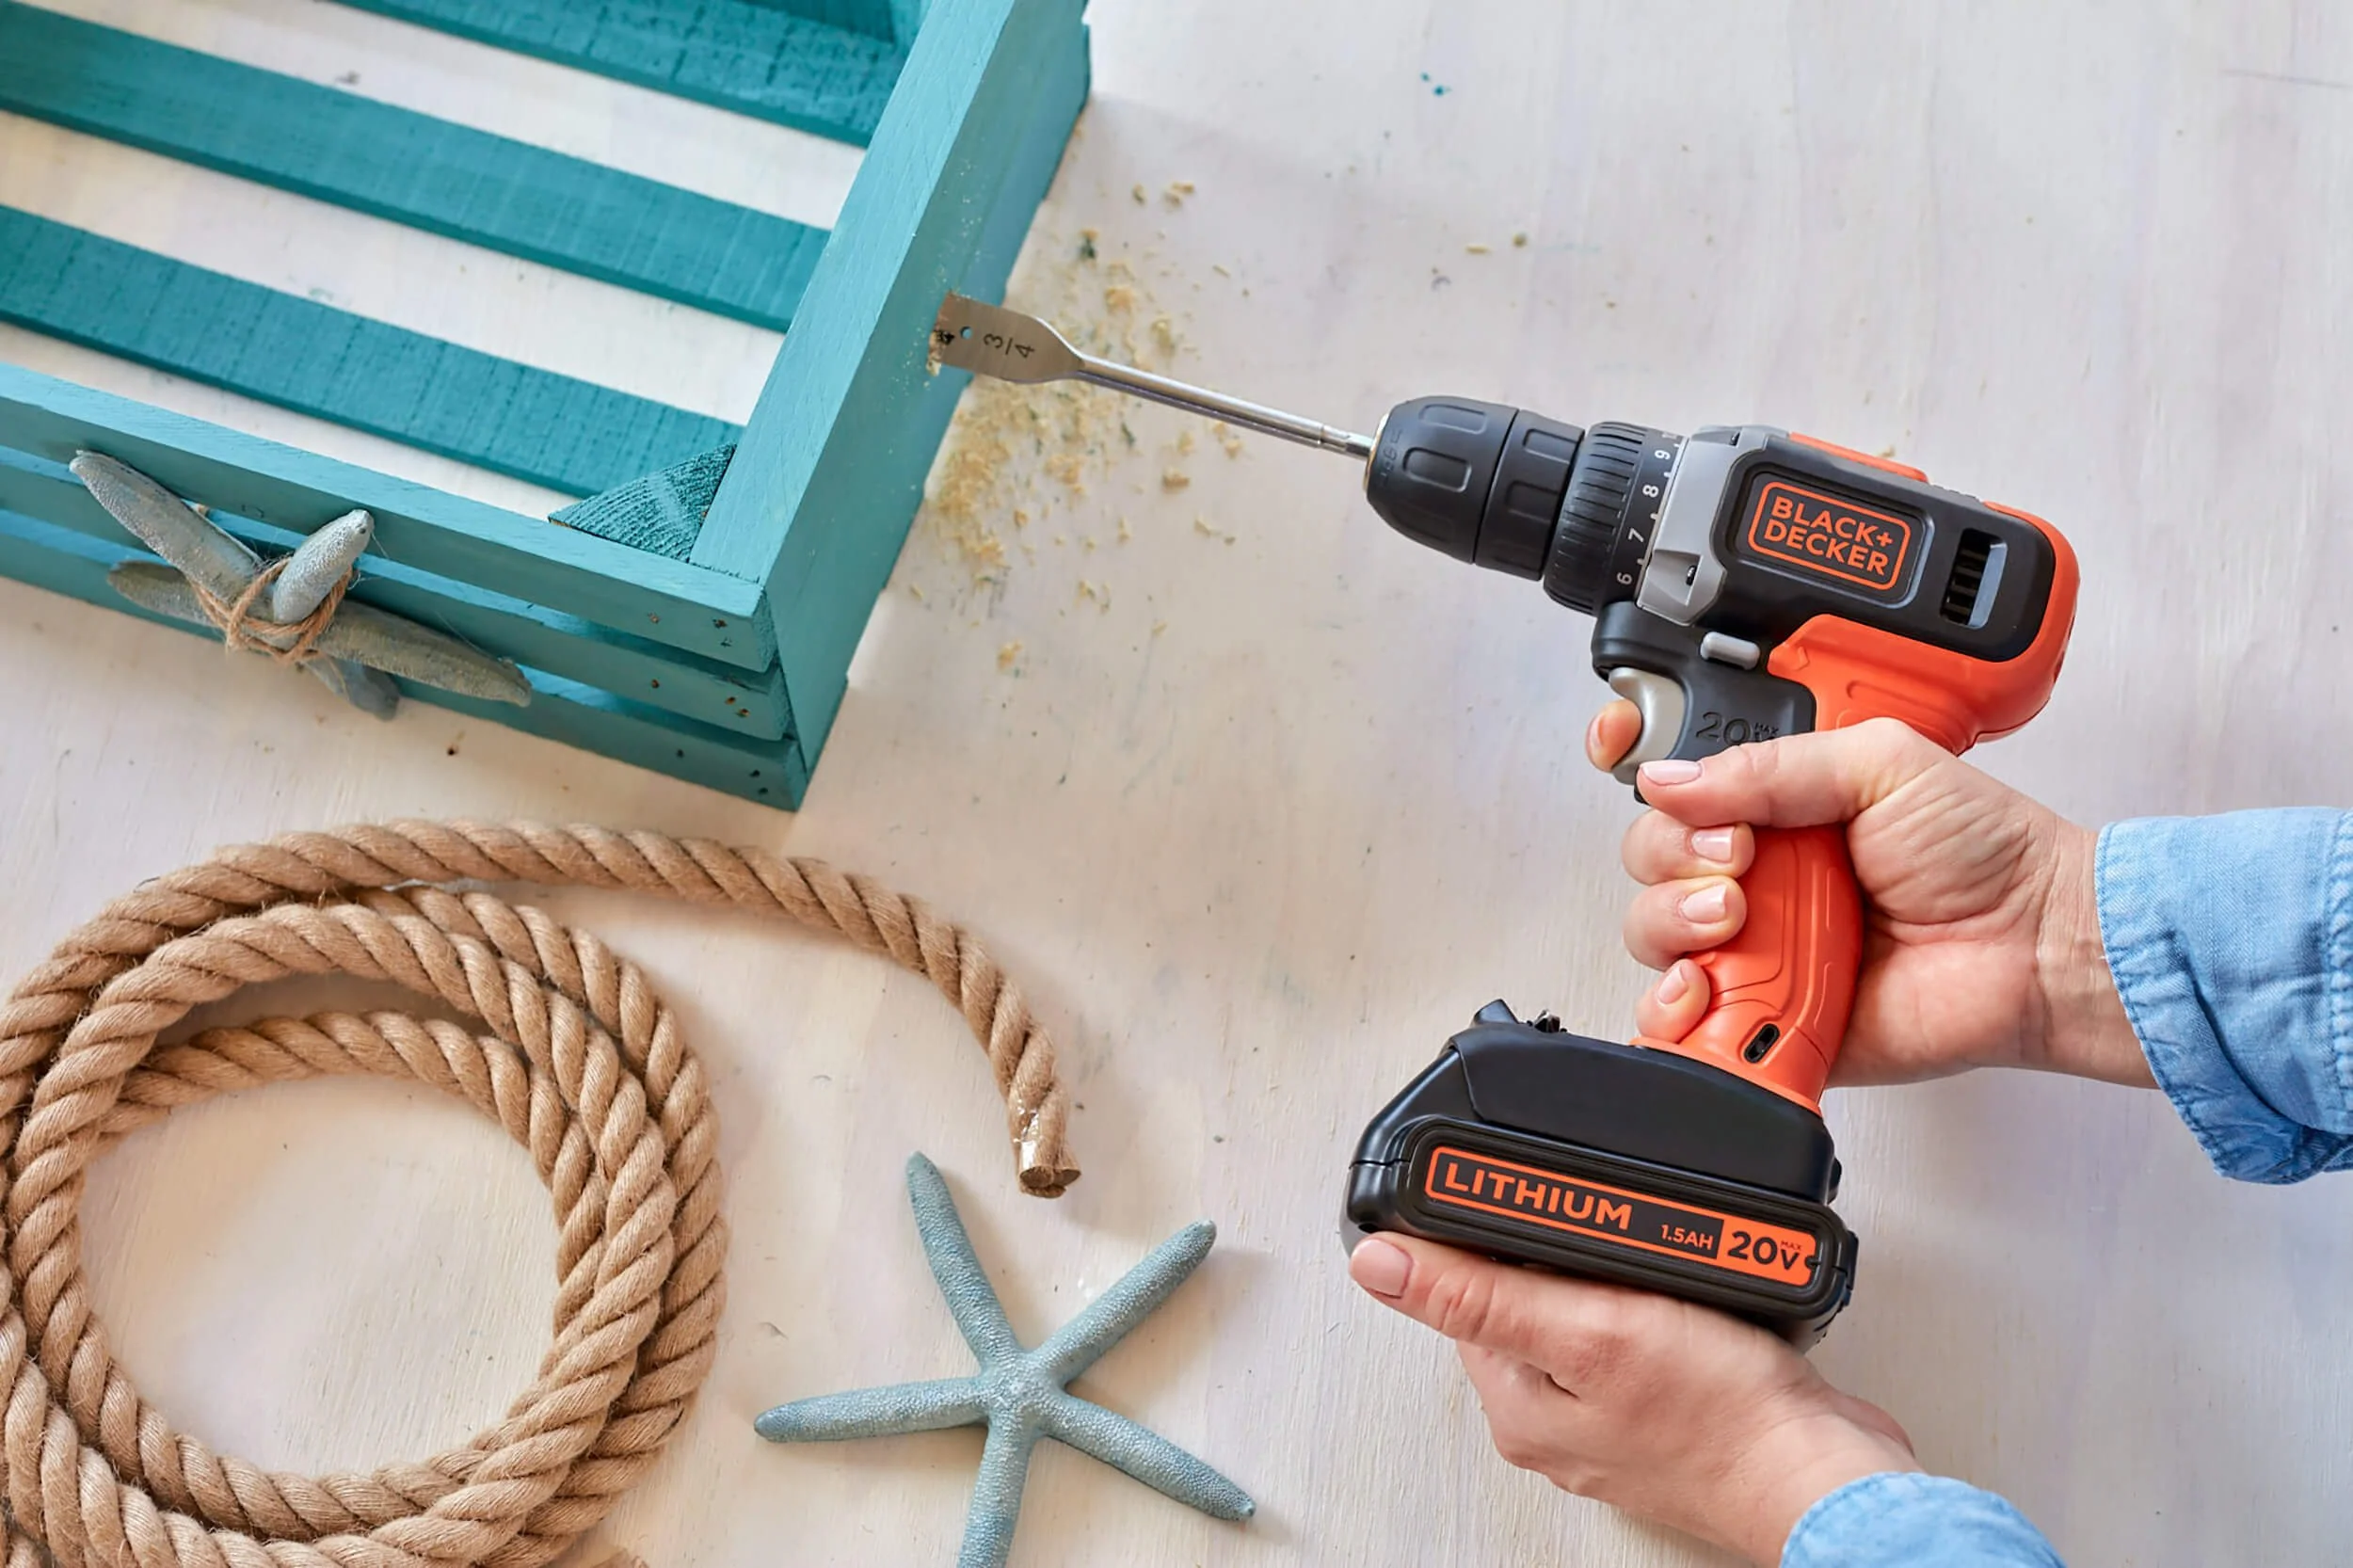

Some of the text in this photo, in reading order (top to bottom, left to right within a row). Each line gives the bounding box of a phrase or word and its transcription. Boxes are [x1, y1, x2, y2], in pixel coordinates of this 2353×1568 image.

[1654, 449, 1671, 460] 9
[1642, 484, 1659, 498] 8
[1627, 527, 1644, 543] 7
[1763, 519, 1889, 576] DECKER
[1616, 571, 1633, 585] 6
[1444, 1161, 1633, 1231] LITHIUM
[1660, 1223, 1714, 1252] 1.5AH
[1781, 1240, 1802, 1251] MAX
